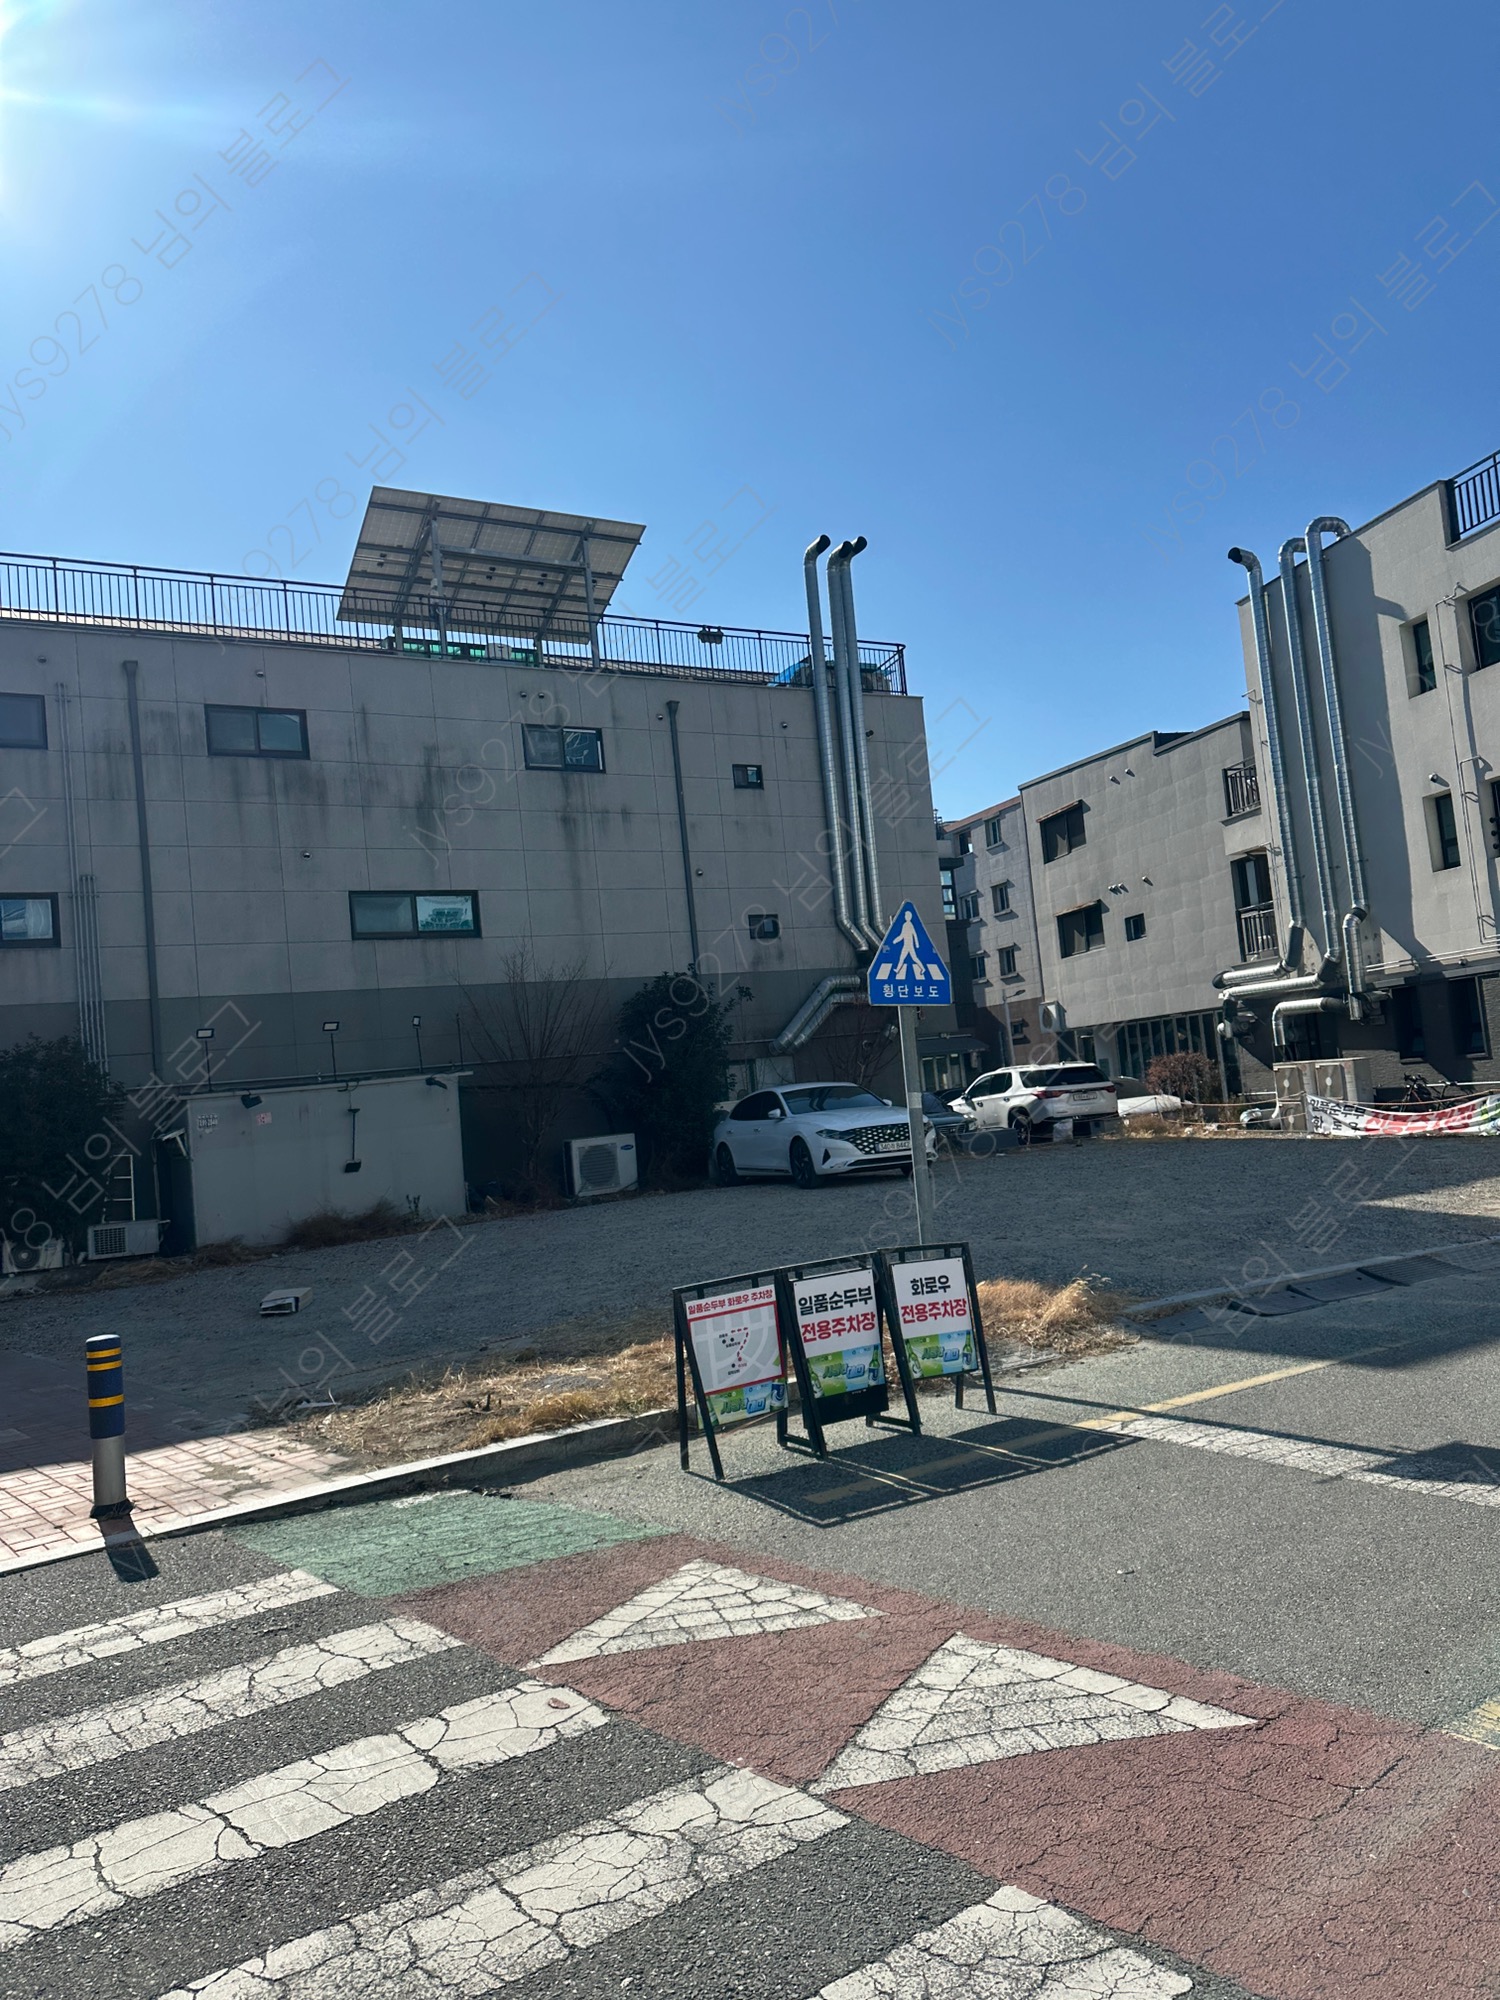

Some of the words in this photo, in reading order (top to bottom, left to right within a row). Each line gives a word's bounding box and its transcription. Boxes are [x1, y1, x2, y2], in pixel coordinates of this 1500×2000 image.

[883, 984, 939, 998] 횡단보도
[910, 1275, 951, 1296] 화로우
[688, 1299, 726, 1315] 일품순두부
[727, 1294, 749, 1307] 화로우
[751, 1289, 773, 1302] 주차장
[798, 1285, 873, 1316] 일품순두부
[901, 1298, 967, 1324] 전용주차장
[801, 1311, 876, 1343] 전용주차장
